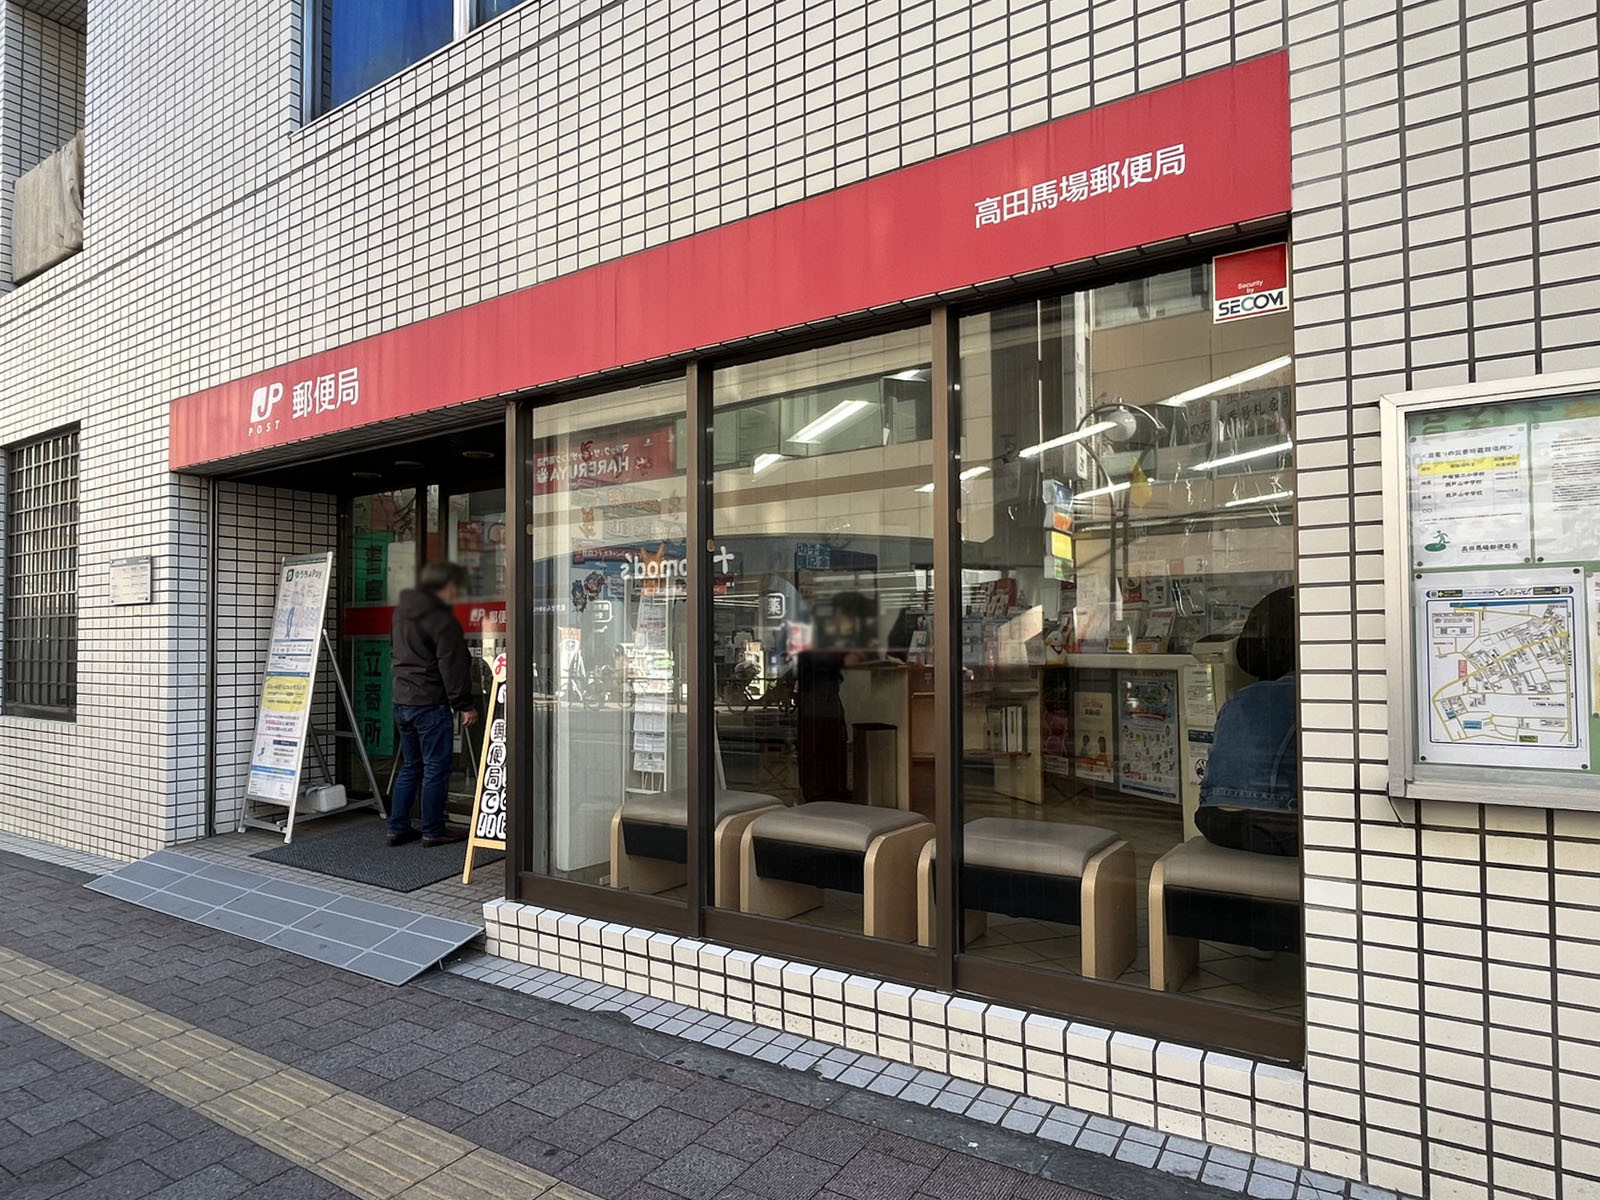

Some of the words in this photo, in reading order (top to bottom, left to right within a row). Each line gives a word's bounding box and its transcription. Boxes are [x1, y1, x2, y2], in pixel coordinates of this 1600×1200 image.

[974, 143, 1186, 229] 高田馬場郵便局
[1237, 280, 1263, 290] Security
[1218, 290, 1284, 317] SECOM
[250, 382, 283, 423] JP
[292, 367, 359, 419] 郵便局
[248, 420, 280, 437] POST
